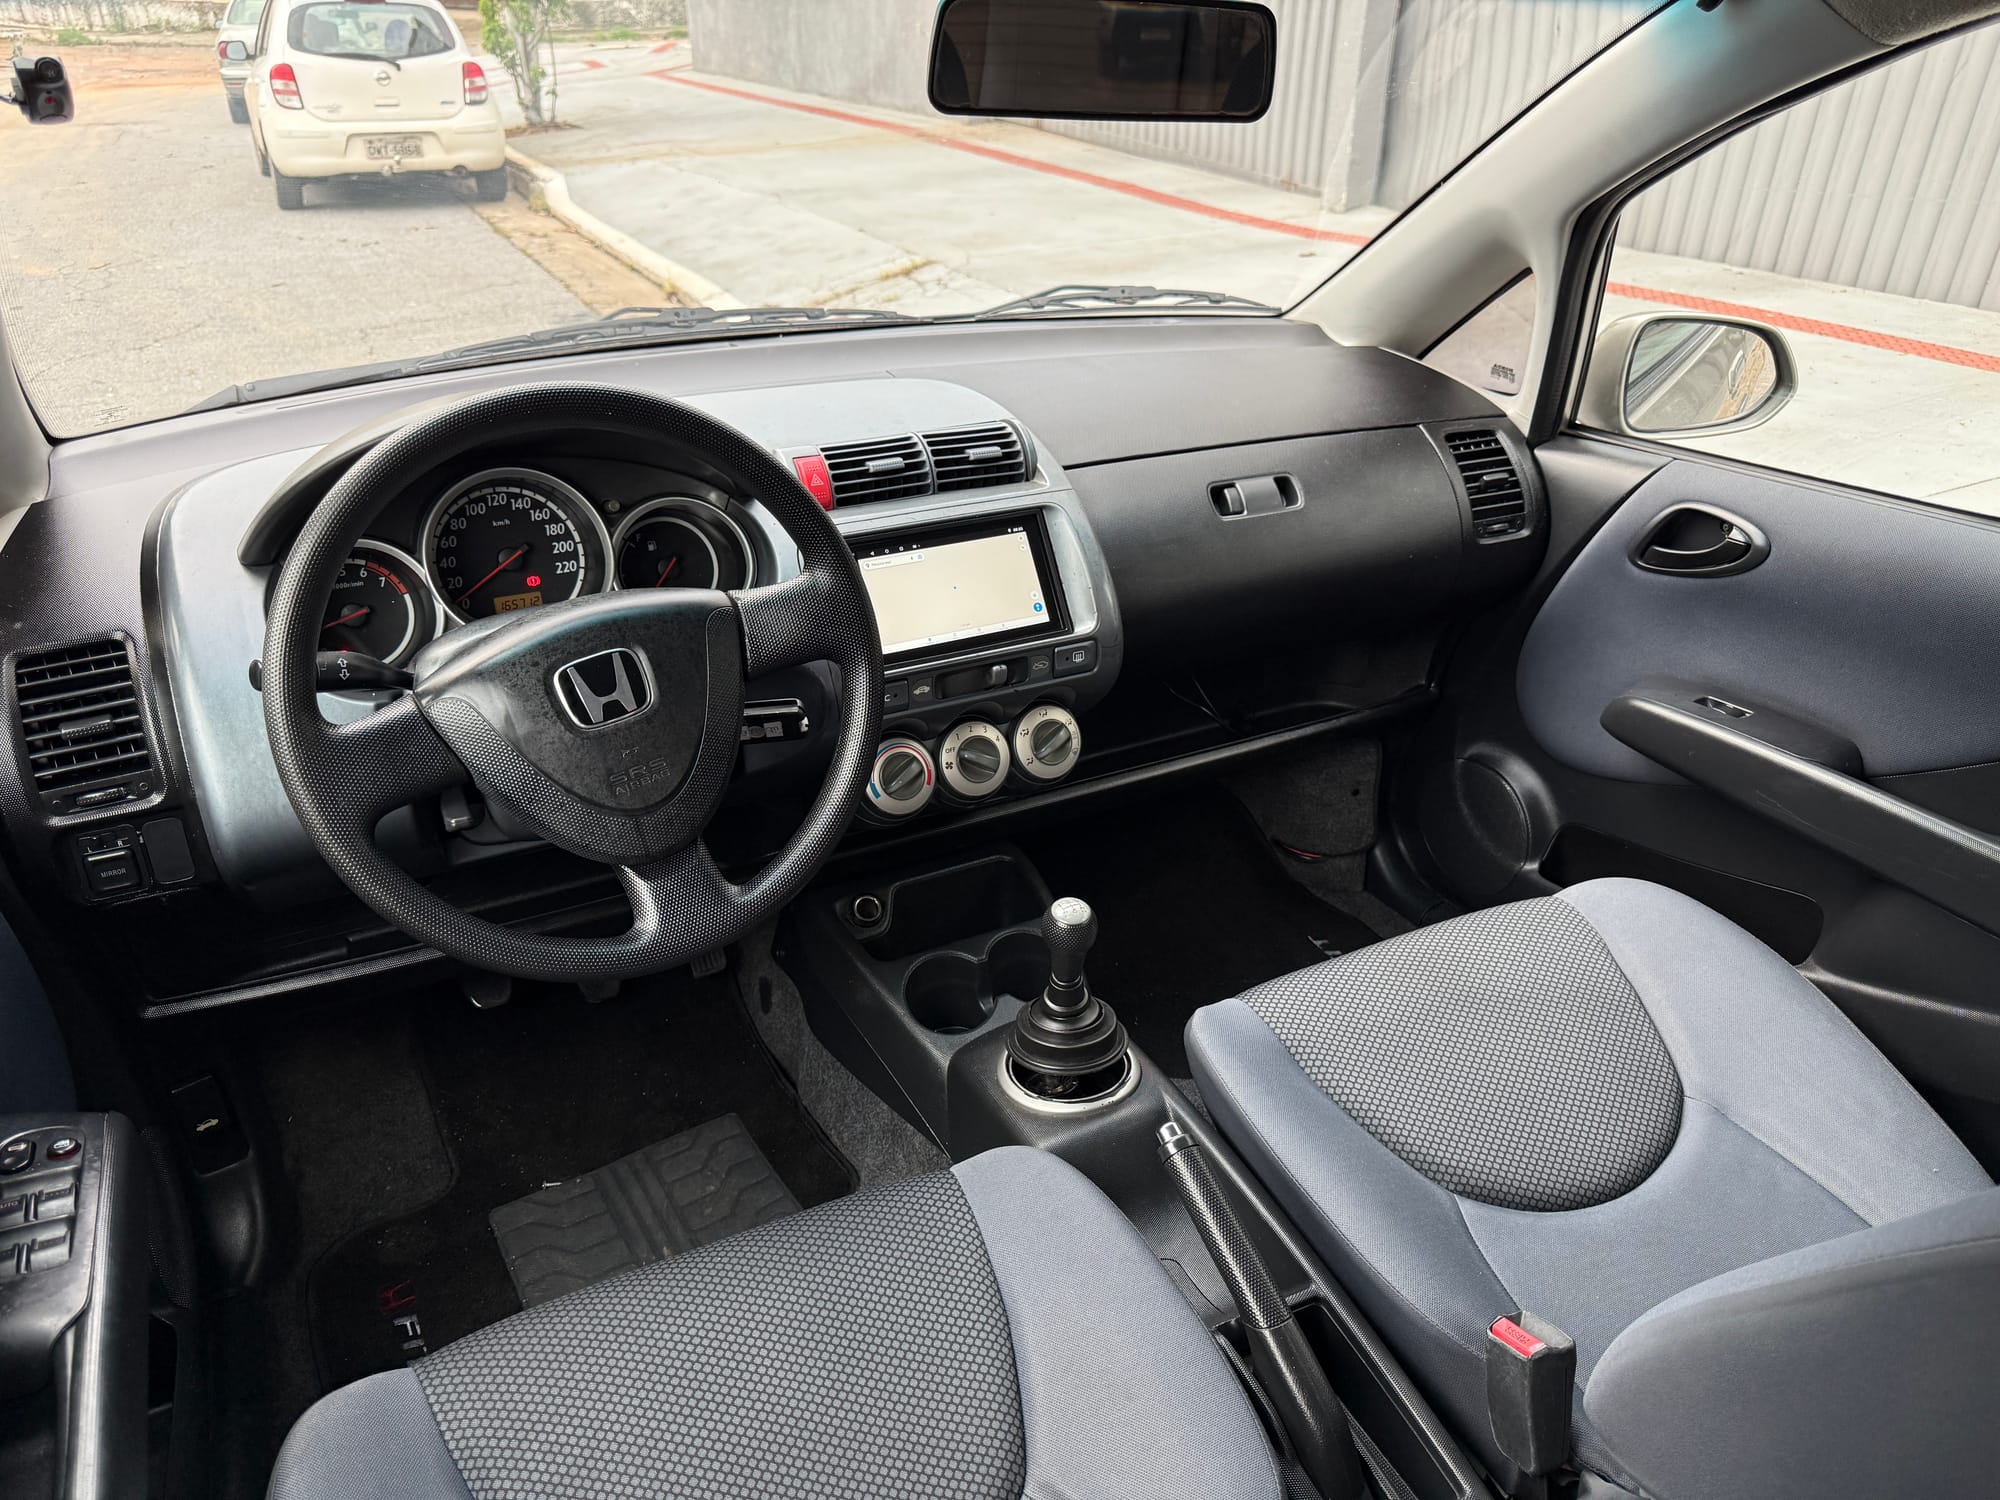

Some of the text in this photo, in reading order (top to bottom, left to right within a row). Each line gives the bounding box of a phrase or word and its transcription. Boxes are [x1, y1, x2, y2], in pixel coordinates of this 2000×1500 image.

[486, 493, 507, 507] 120
[510, 497, 532, 511] 140
[465, 503, 486, 516] 100
[530, 508, 550, 522] 160
[450, 517, 467, 531] 80
[492, 518, 511, 527] km/h
[544, 522, 566, 537] 180
[440, 536, 457, 549] 60
[552, 540, 575, 554] 200
[440, 556, 456, 569] 40
[555, 560, 578, 575] 220
[360, 568, 367, 578] 6
[379, 577, 385, 588] 7
[447, 576, 463, 589] 20
[462, 598, 470, 610] 0
[501, 596, 541, 611] 165712
[968, 725, 973, 733] 2
[609, 757, 667, 786] SRS
[615, 768, 672, 796] AIRBAG
[101, 867, 127, 878] MIRROR
[0, 1200, 18, 1209] UTO
